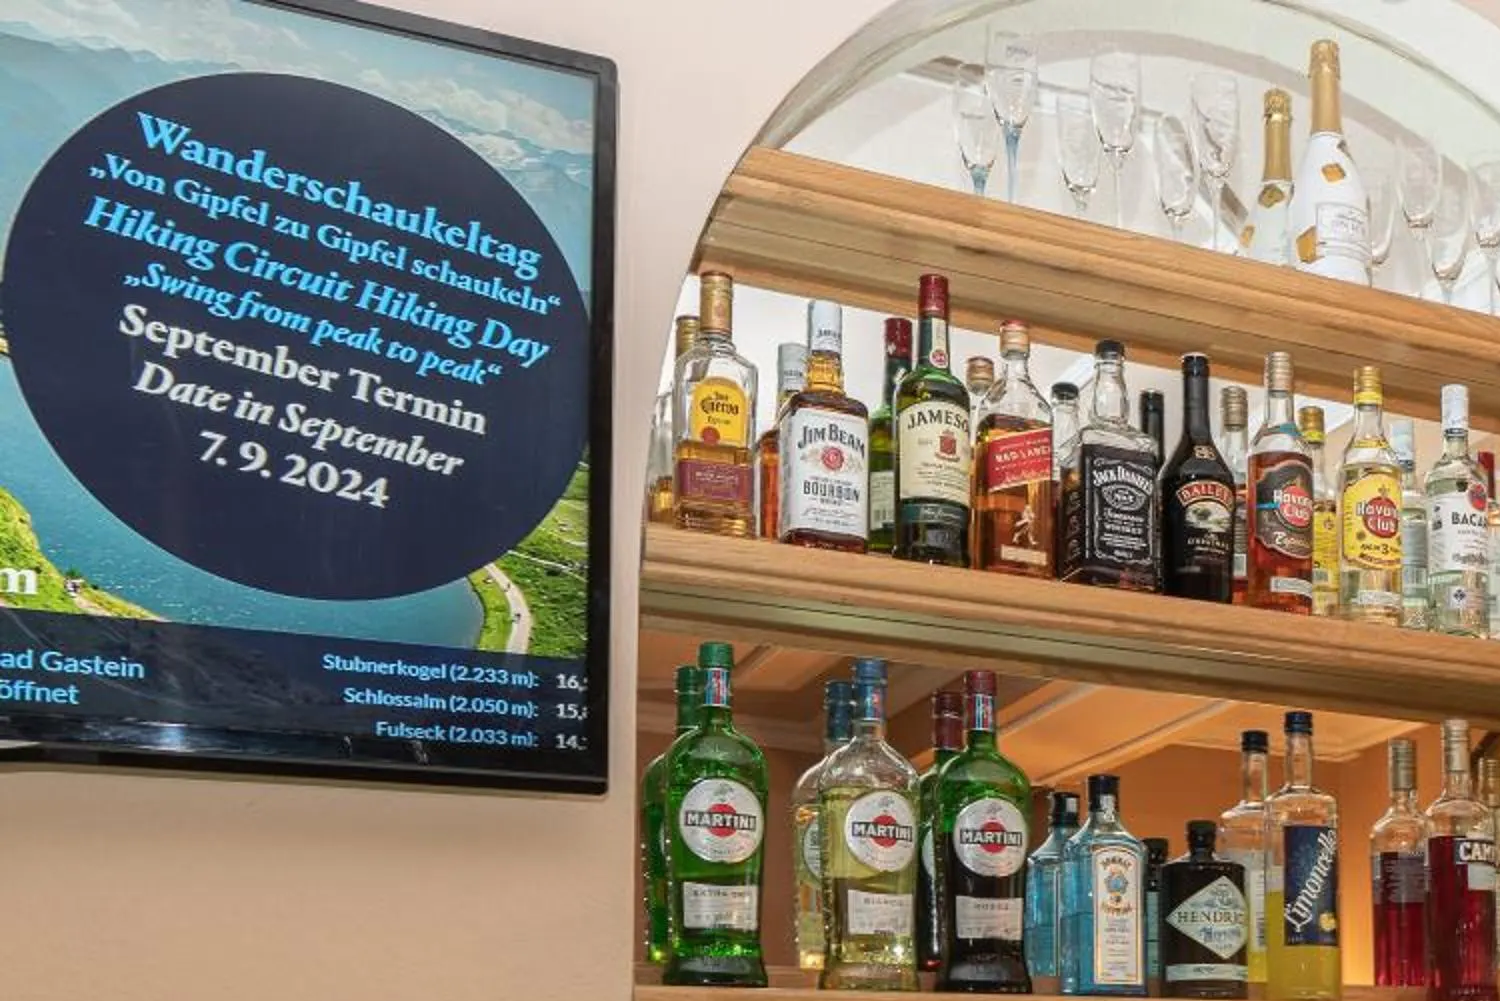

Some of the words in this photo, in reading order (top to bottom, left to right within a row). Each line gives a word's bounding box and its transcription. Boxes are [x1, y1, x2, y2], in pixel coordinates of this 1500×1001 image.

[137, 111, 542, 281] Wanderschaukeltag
[174, 180, 269, 228] Gipfel
[275, 215, 309, 241] zu
[316, 224, 406, 270] Gipfel
[84, 197, 220, 270] Hiking
[224, 241, 353, 302] Circuit
[356, 280, 476, 350] Hiking
[481, 319, 550, 367] Day
[230, 294, 311, 336] from
[311, 317, 383, 355] peak
[386, 341, 417, 365] to
[119, 303, 341, 393] September
[349, 369, 487, 434] Termin
[134, 361, 231, 413] Date
[234, 391, 275, 425] in
[278, 403, 465, 476] September
[797, 424, 826, 450] JIM
[829, 423, 866, 459] BEAM
[803, 479, 861, 504] BOURBON
[40, 650, 145, 679] Gastein
[322, 654, 447, 681] Stubnerkogel
[450, 664, 509, 685] (2.233
[343, 687, 447, 711] Schlossalm
[450, 695, 508, 715] (2.050
[375, 721, 446, 741] Fulseck
[450, 726, 508, 746] (2.033
[686, 812, 757, 831] MARTINI
[852, 822, 912, 841] MARTINI
[961, 830, 1022, 847] MARTINI
